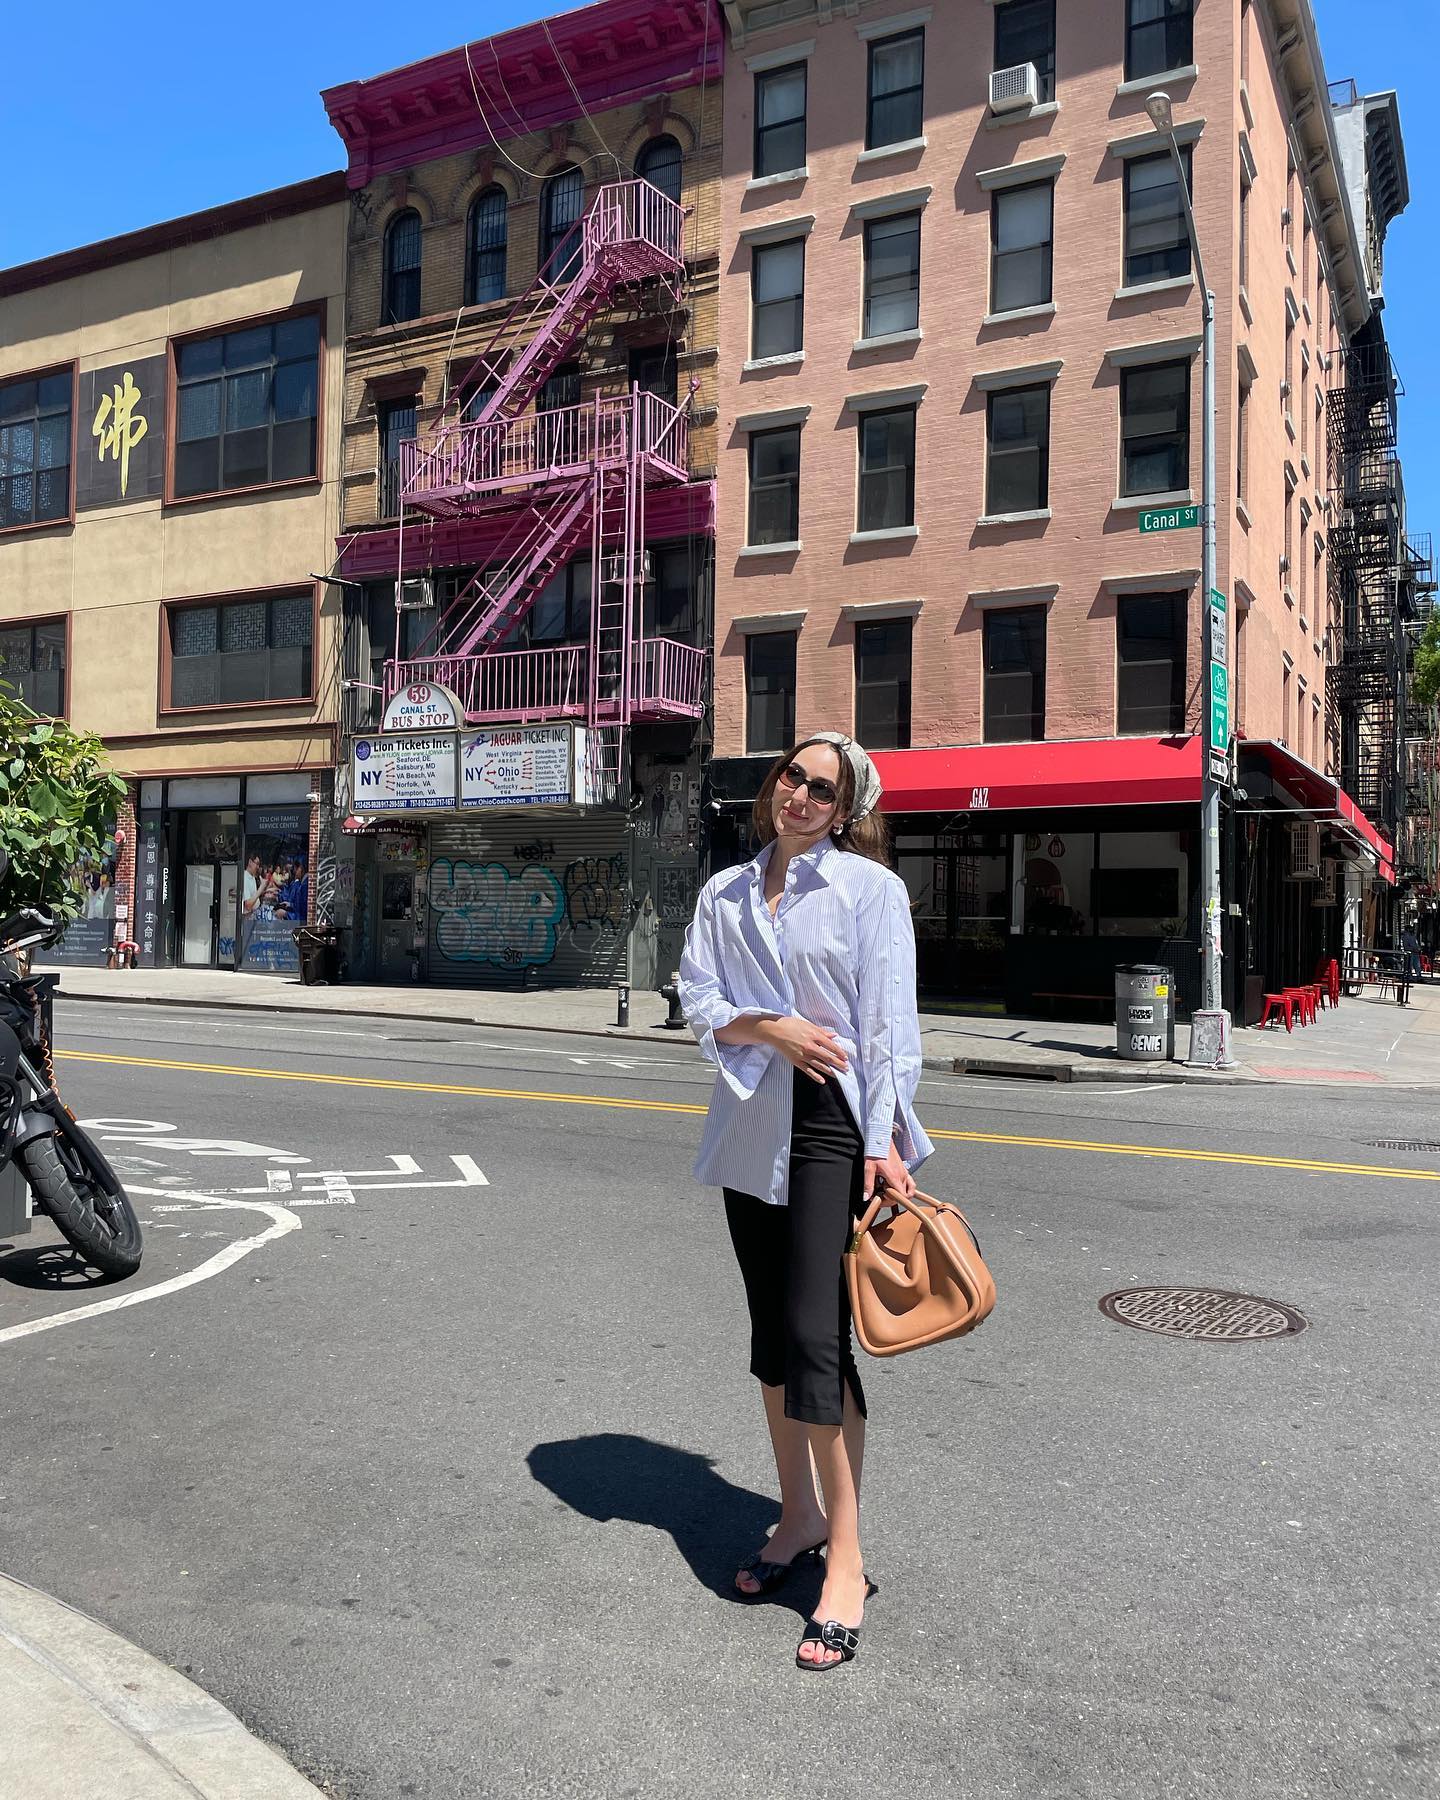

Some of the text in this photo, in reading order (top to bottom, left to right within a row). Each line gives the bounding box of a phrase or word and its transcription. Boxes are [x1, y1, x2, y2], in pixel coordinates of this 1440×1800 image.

[1144, 509, 1194, 530] Canal St
[411, 686, 429, 703] 59
[400, 704, 437, 715] CANAL ST.
[391, 713, 449, 728] BUS STOP
[490, 728, 569, 747] JAGUAR TICKET INC.
[373, 738, 450, 752] Lion Tickets Inc.
[501, 750, 522, 758] Virginia
[396, 756, 421, 764] Seaford,
[396, 764, 425, 772] Salisbury,
[497, 766, 520, 777] Ohio
[361, 770, 382, 786] NY
[406, 771, 426, 780] Beach,
[465, 767, 484, 782] NY
[396, 781, 420, 789] Norfolk,
[493, 783, 518, 791] Kentucky
[396, 789, 425, 797] Hampton,
[463, 797, 526, 806] www.OhioCoach.com
[214, 833, 224, 844] 61
[1131, 1034, 1161, 1052] GENIE
